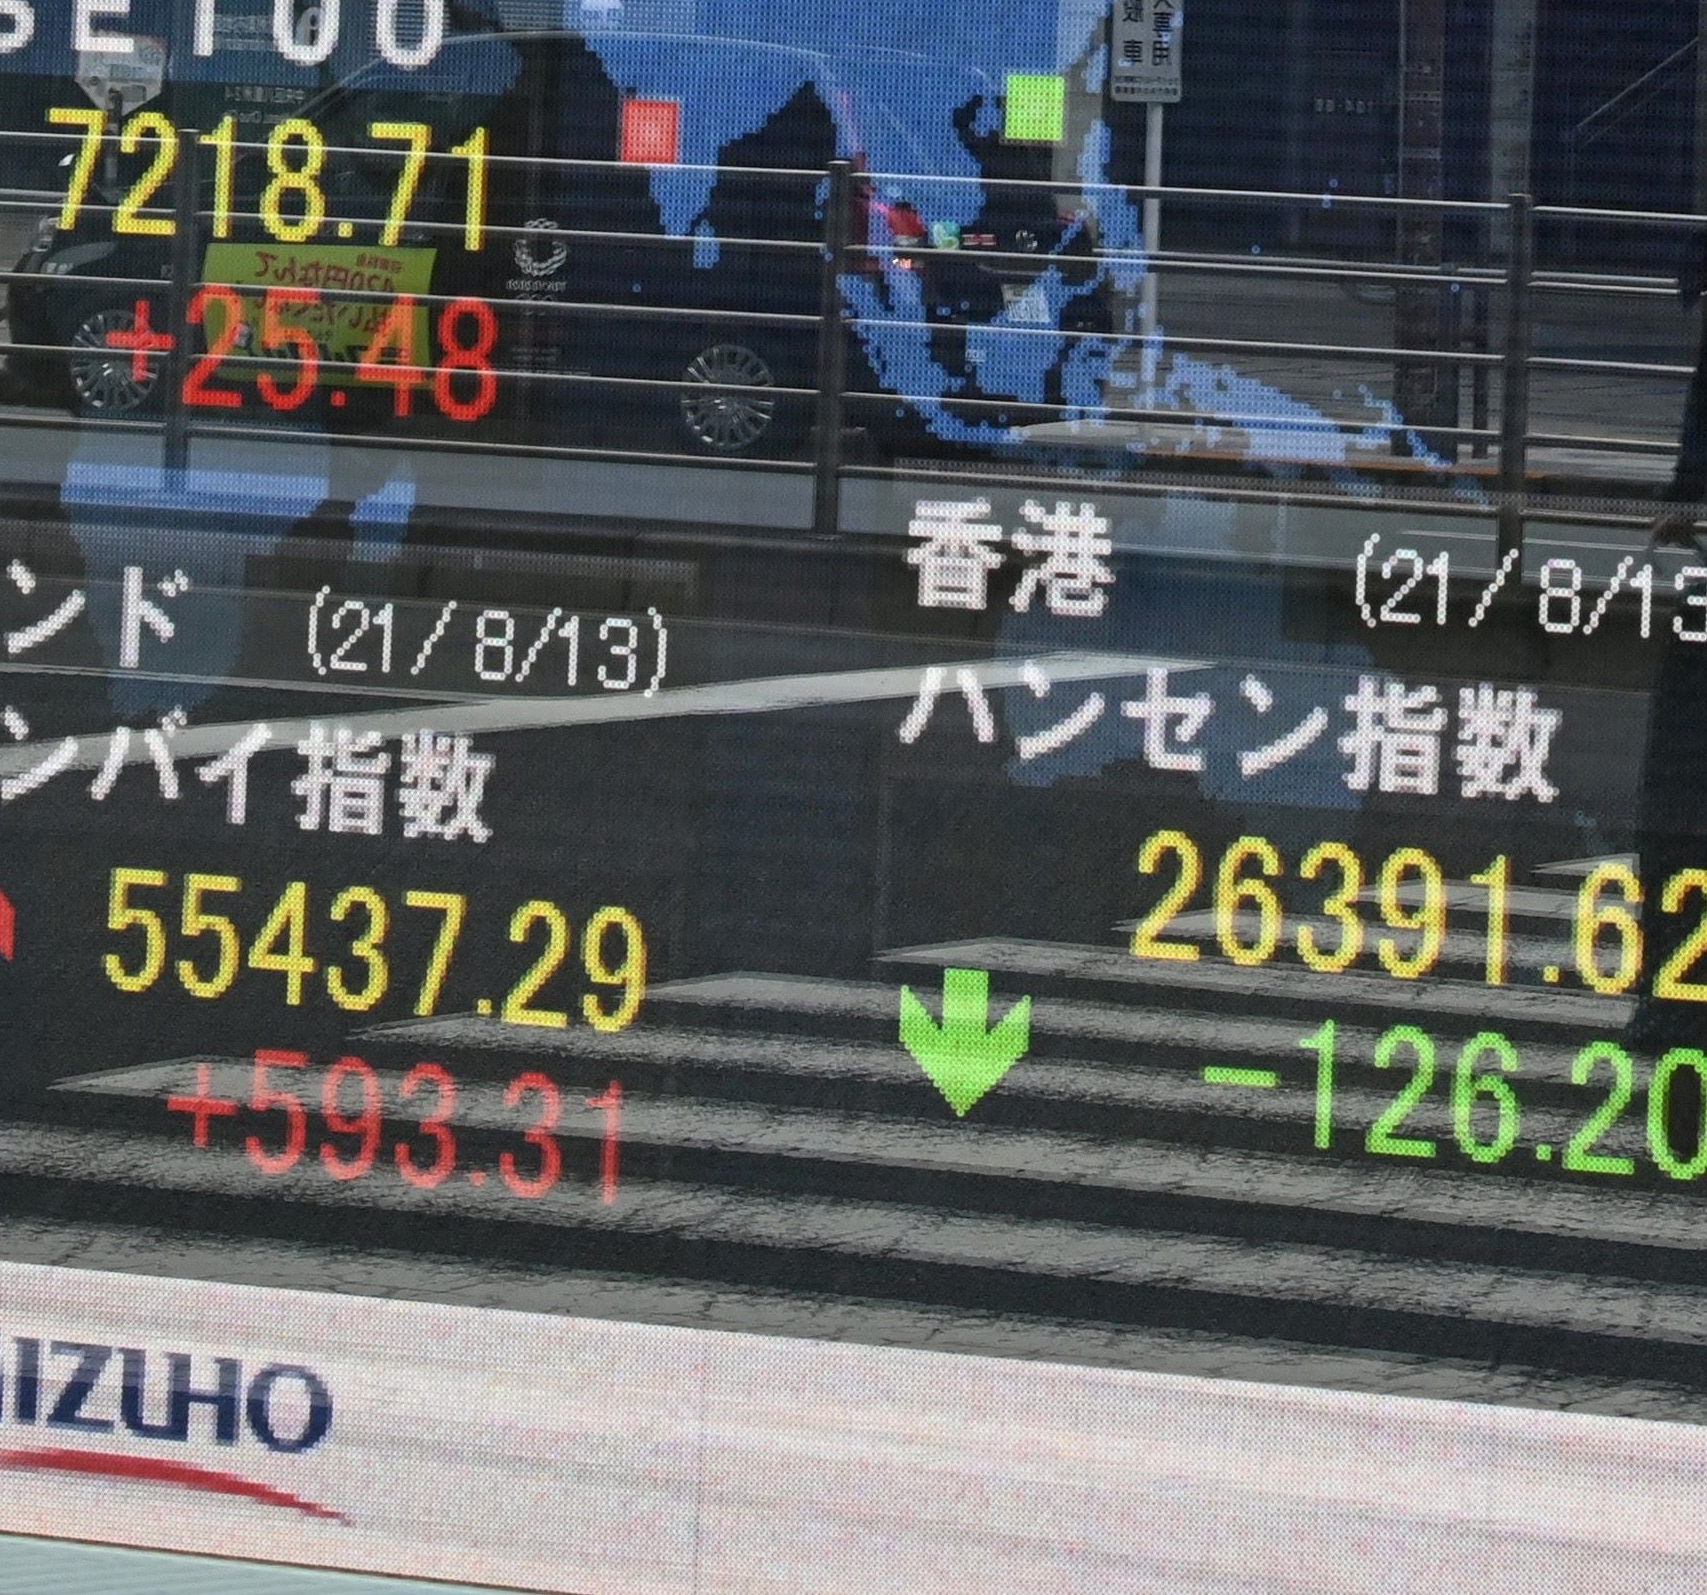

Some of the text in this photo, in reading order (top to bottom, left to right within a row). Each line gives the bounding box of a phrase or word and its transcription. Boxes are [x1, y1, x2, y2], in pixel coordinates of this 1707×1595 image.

[47, 106, 487, 253] 7218.71
[104, 281, 500, 421] +25.48
[905, 496, 1115, 619] 香港
[899, 664, 1563, 805] ハンセン指数
[101, 866, 650, 1033] 55437.29
[165, 1046, 623, 1206] +593.31
